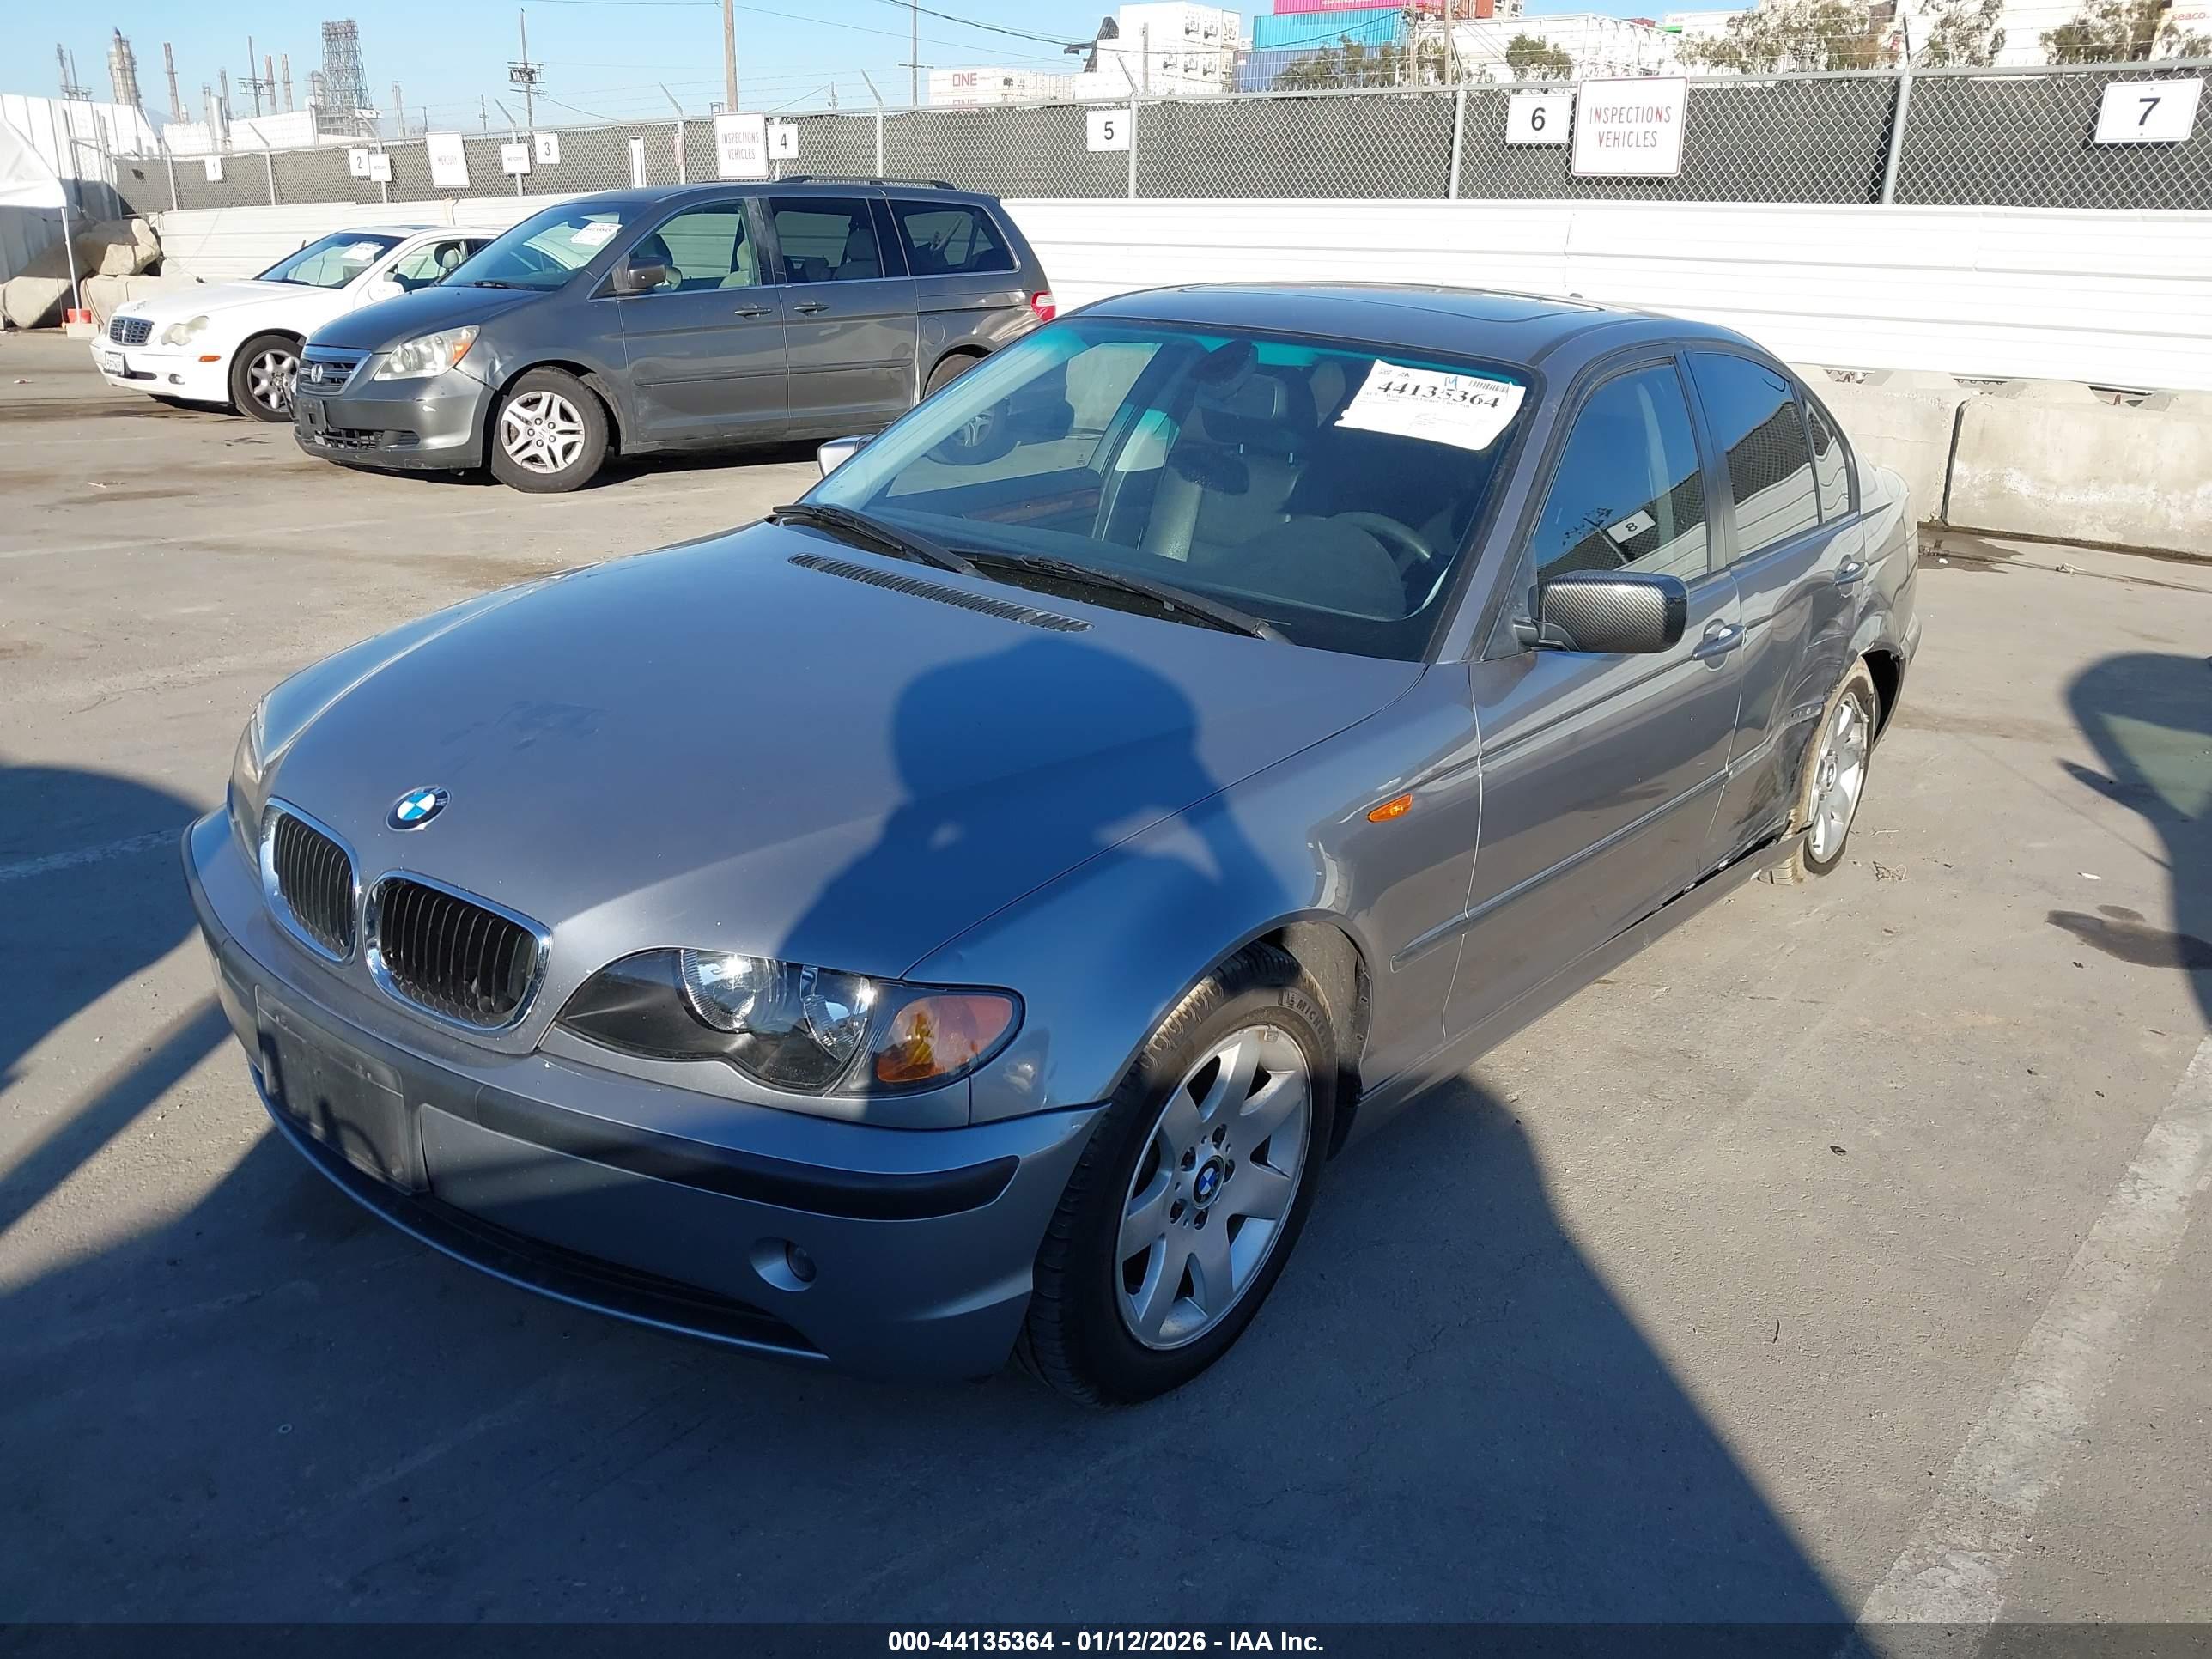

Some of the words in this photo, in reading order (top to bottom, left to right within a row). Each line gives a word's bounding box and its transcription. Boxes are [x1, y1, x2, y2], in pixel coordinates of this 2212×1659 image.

[952, 73, 977, 87] ONE
[1531, 106, 1546, 131] 6
[1589, 106, 1672, 124] INSPECTIONS
[2138, 97, 2161, 126] 7
[721, 132, 760, 144] INSPECTIONS
[1104, 121, 1115, 140] 5
[780, 133, 787, 150] 4
[1598, 131, 1658, 148] VEHICLES
[544, 142, 551, 156] 3
[728, 149, 756, 160] VEHICLES
[356, 156, 362, 169] 2
[1377, 381, 1501, 408] 44135364
